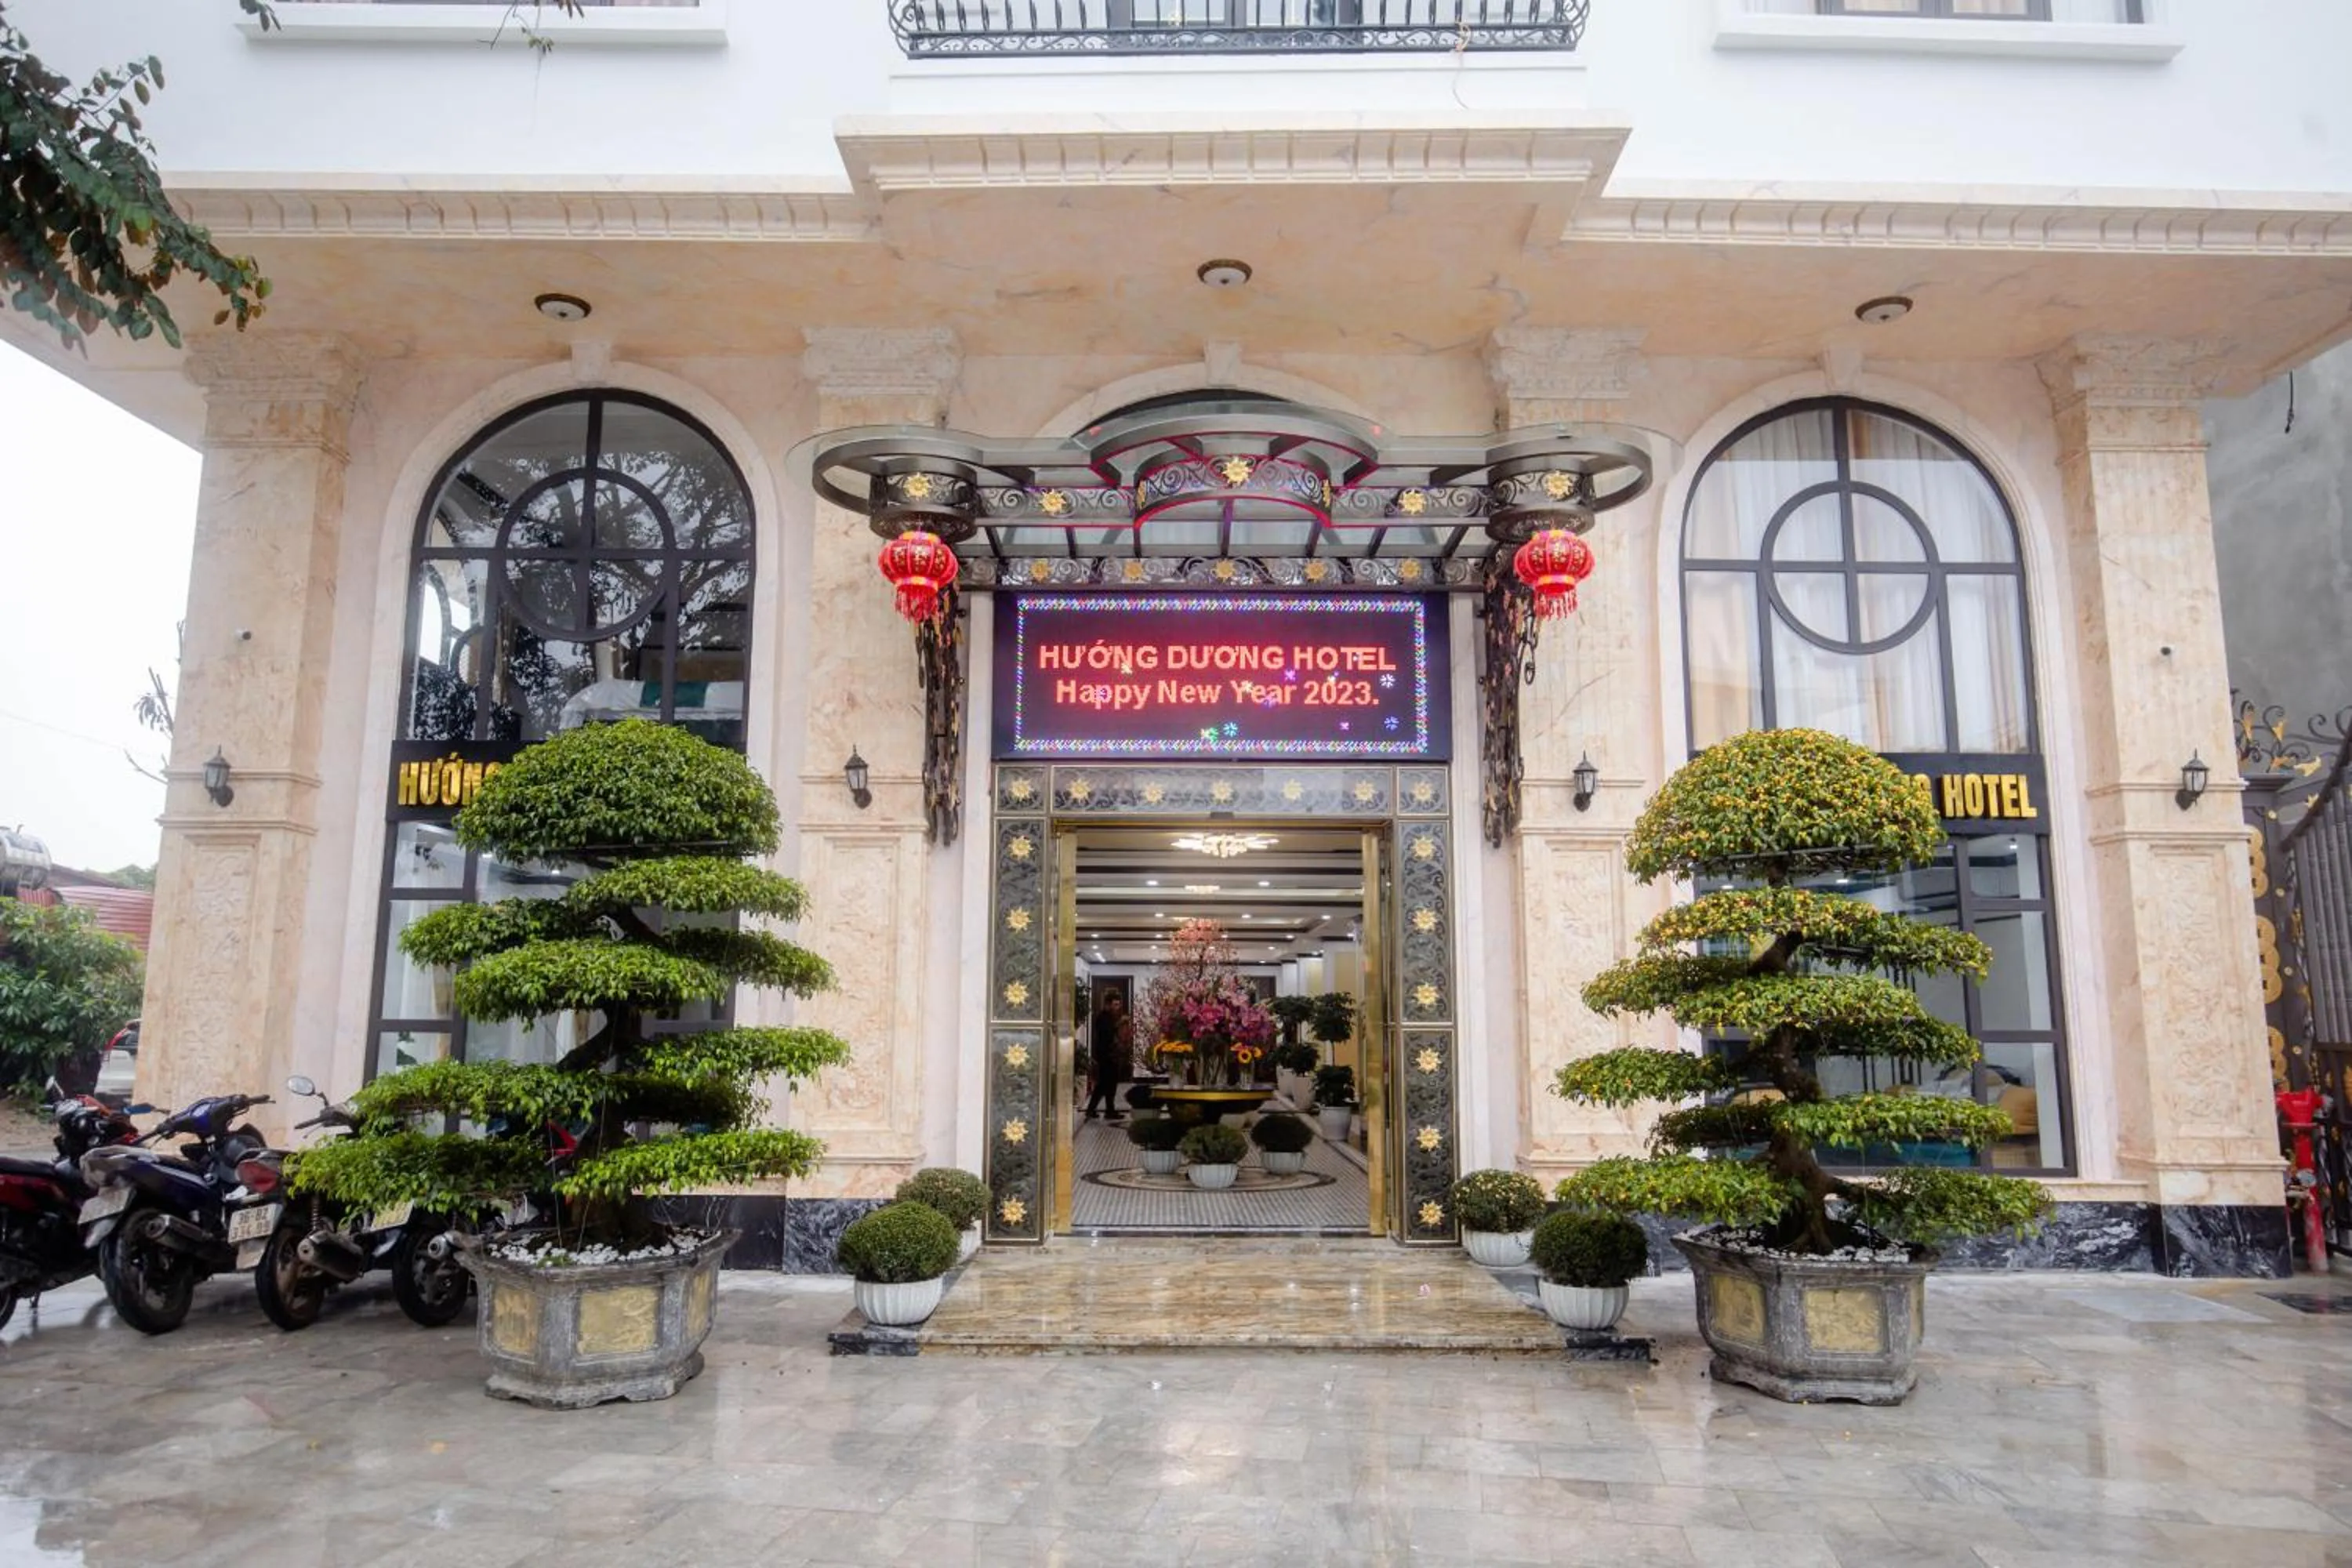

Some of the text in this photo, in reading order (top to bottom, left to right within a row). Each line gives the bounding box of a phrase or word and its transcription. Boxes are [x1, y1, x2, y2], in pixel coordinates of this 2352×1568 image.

[1040, 640, 1396, 670] HƯỚNG DƯƠNG HOTEL
[1056, 679, 1380, 710] Happy New Year 2023.
[397, 752, 503, 805] HƯỚN
[1942, 773, 2038, 818] HOTEL
